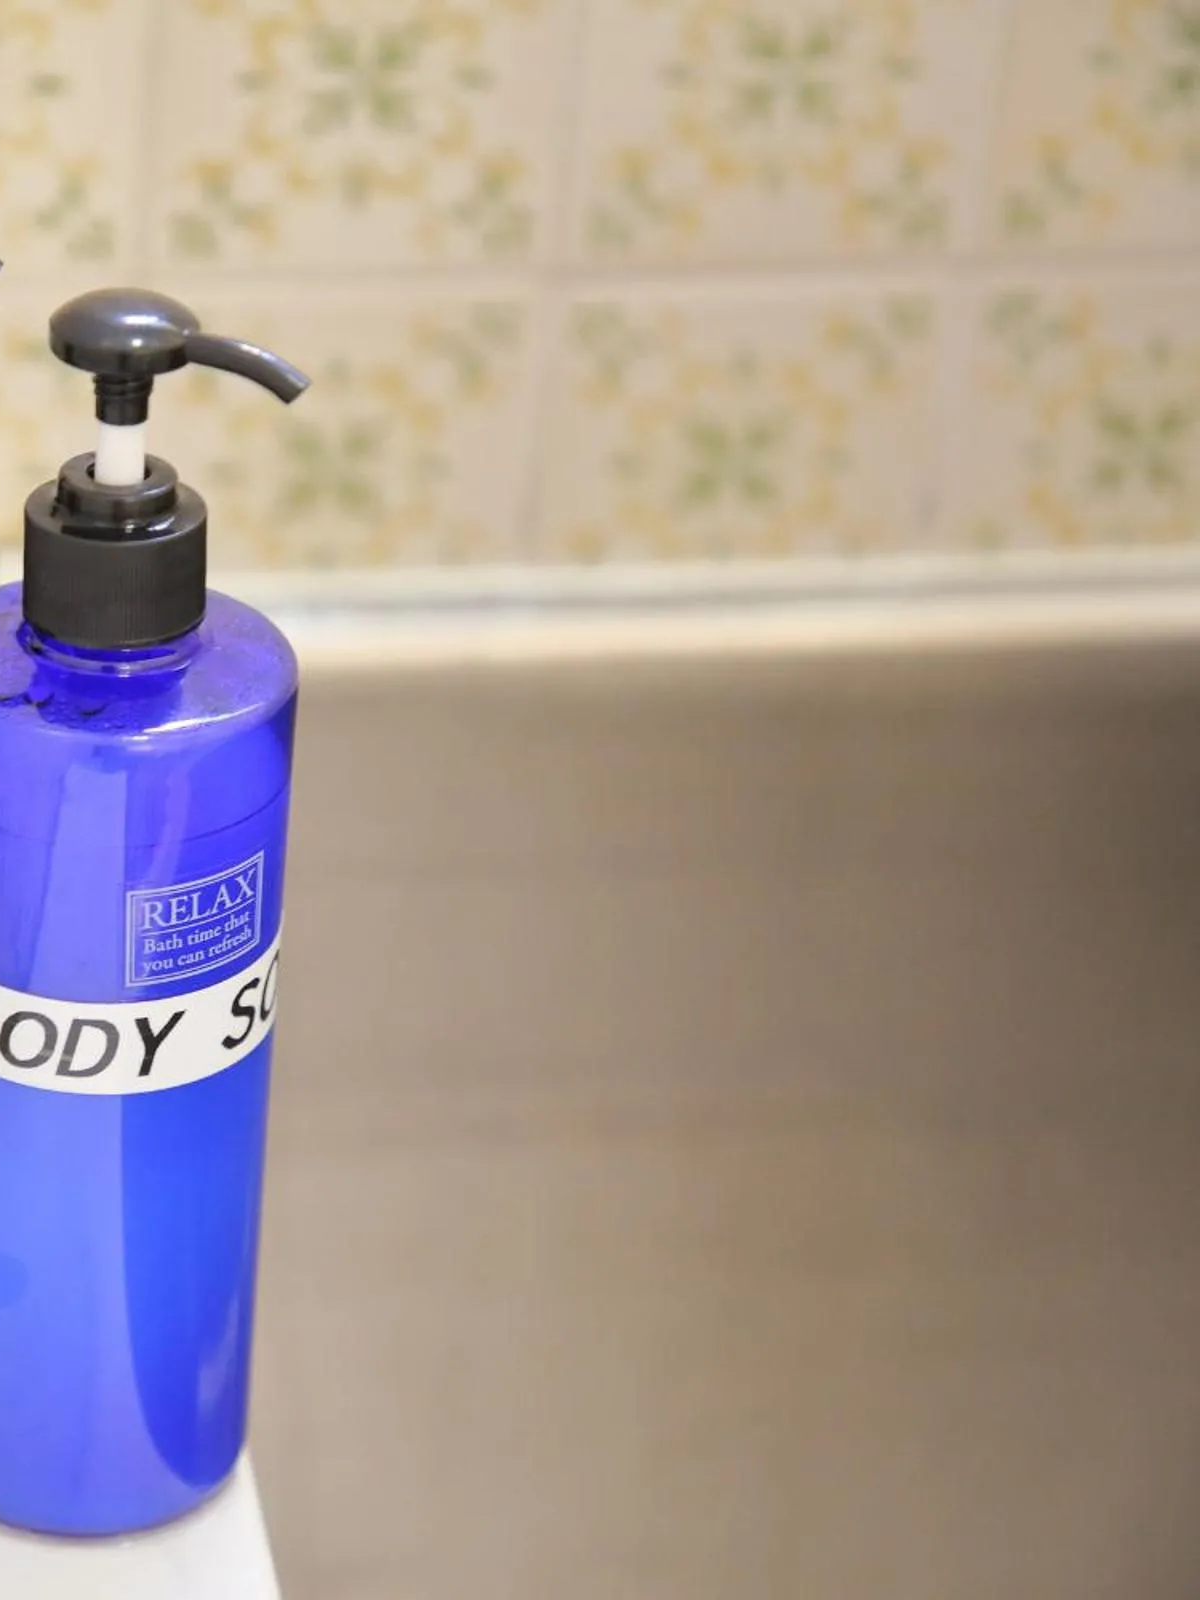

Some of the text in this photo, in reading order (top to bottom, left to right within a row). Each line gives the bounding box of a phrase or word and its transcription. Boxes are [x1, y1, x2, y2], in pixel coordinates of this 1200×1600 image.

[140, 867, 256, 930] RELAX
[143, 911, 250, 954] Bath time that
[143, 926, 252, 977] you can refresh
